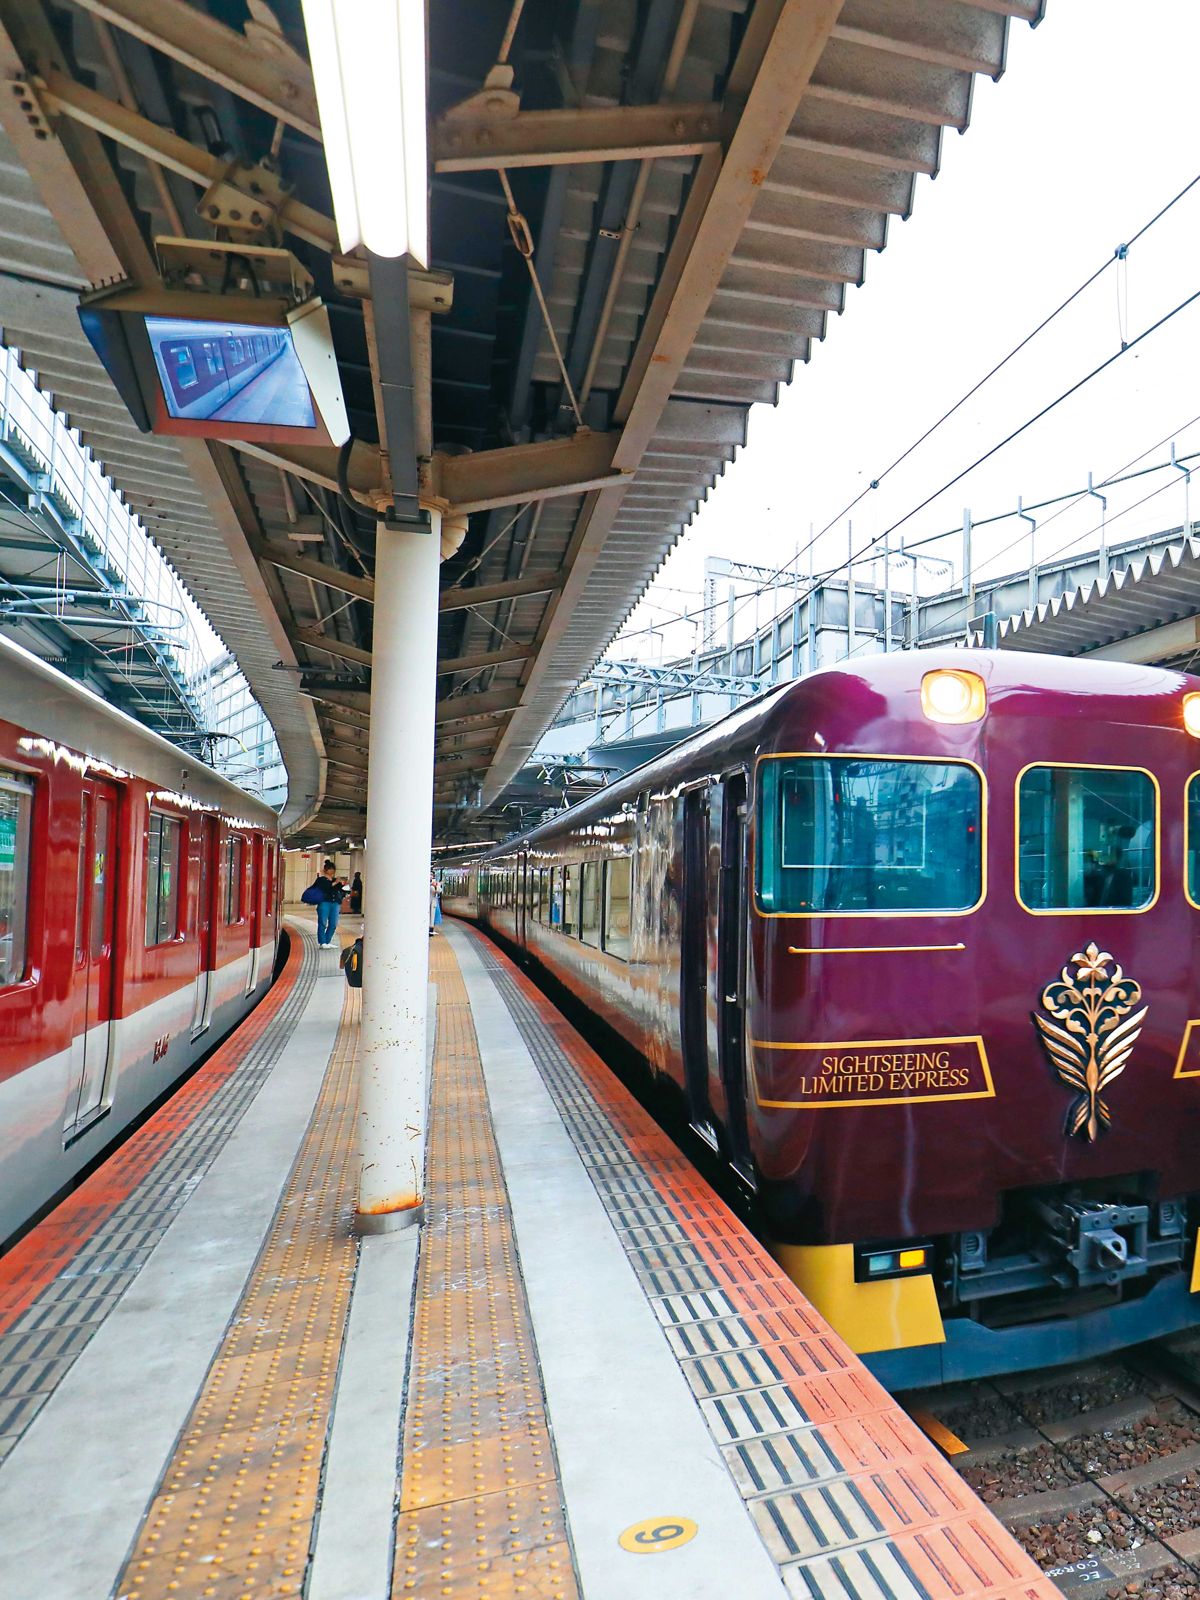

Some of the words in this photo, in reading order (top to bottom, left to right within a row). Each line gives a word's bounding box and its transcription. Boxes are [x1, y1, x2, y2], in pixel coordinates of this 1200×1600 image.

[821, 1051, 950, 1075] SIGHTSEEING
[801, 1074, 884, 1094] LIMITED
[889, 1068, 970, 1090] EXPRESS
